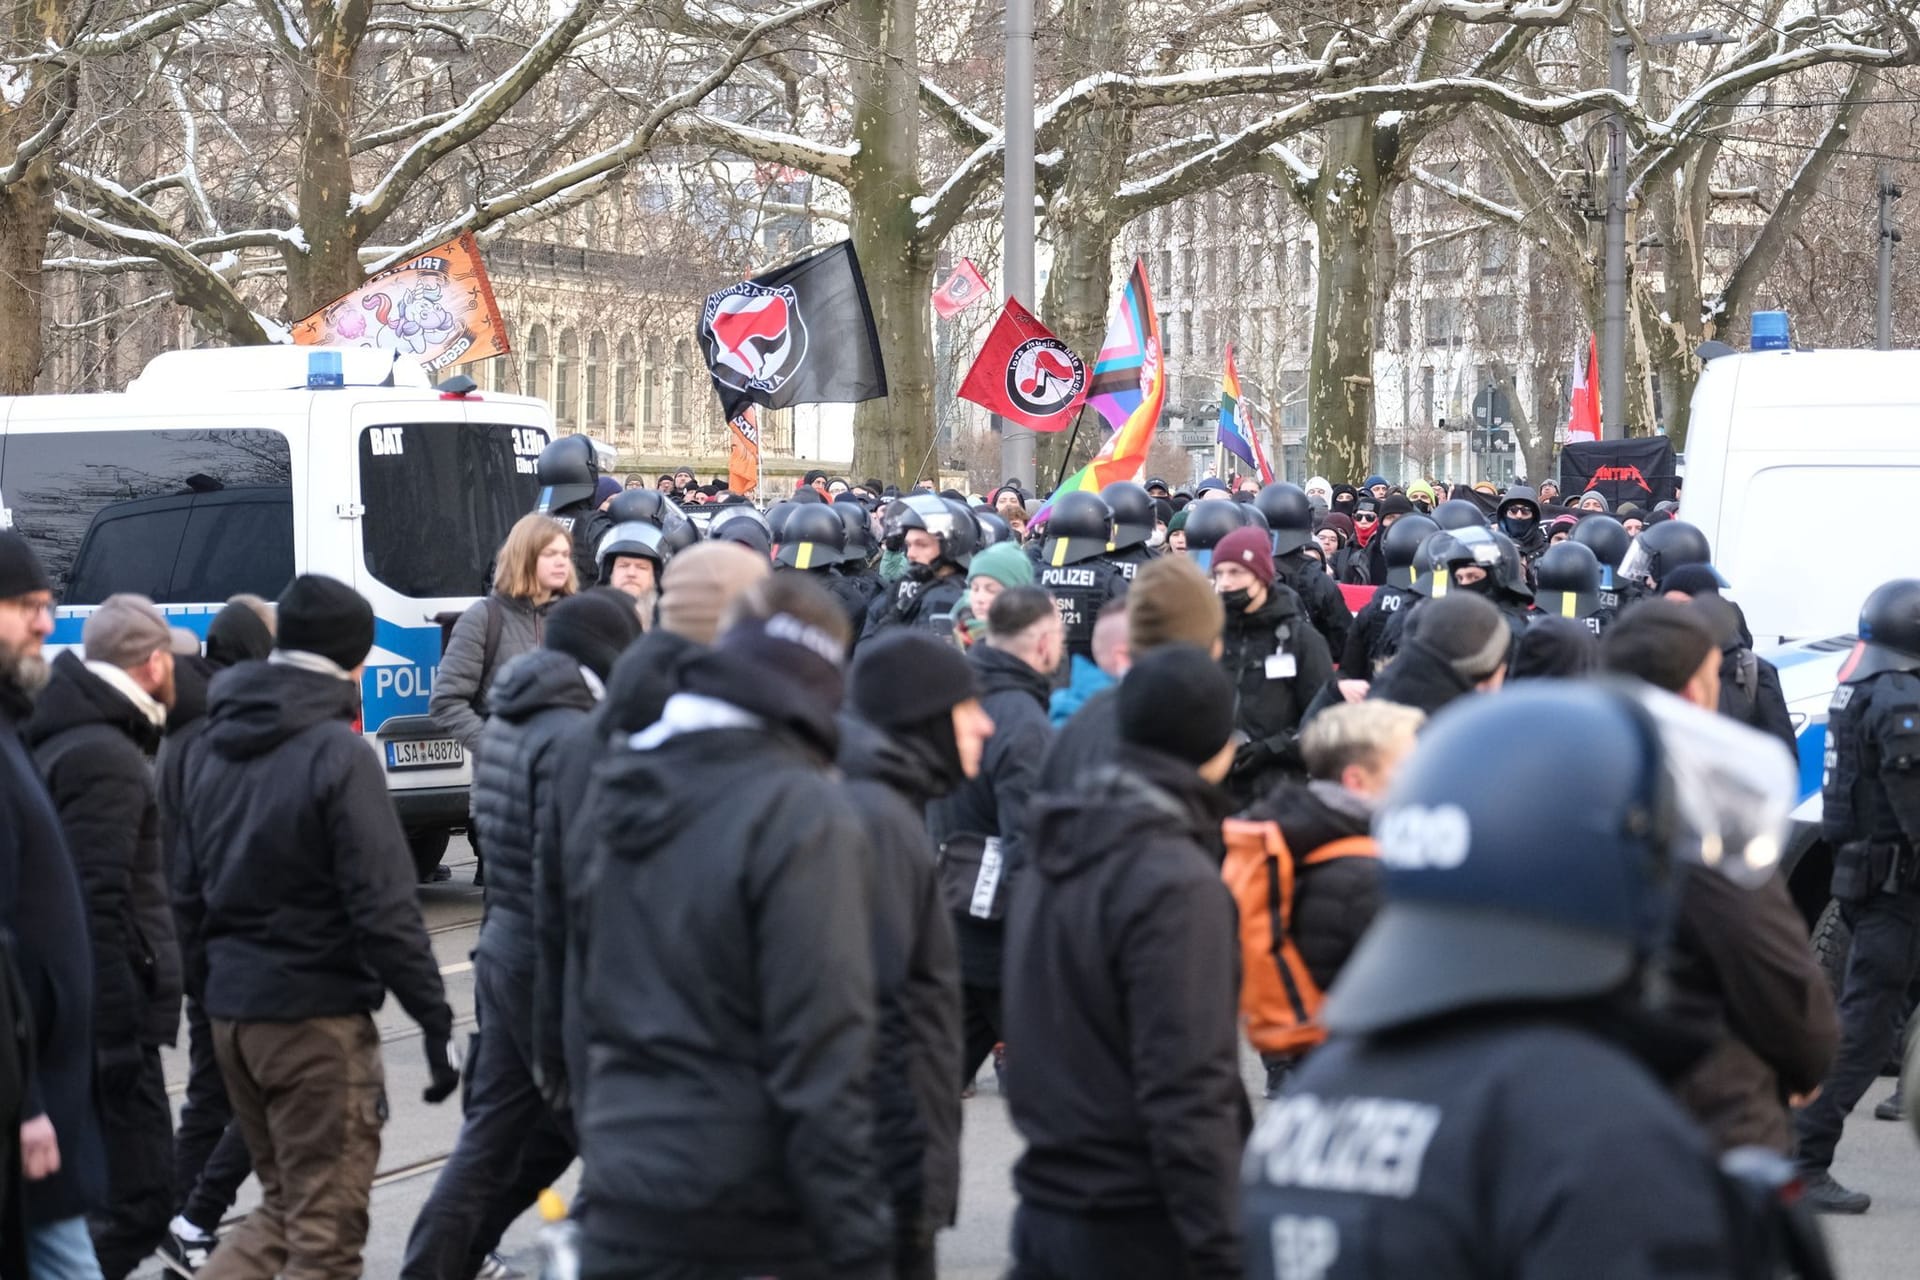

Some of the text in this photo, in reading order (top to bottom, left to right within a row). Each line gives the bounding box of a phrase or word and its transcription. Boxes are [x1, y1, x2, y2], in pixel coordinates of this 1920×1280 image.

[370, 427, 403, 456] BAT
[1583, 464, 1653, 493] ANTIFA
[1041, 569, 1095, 586] POLIZEI
[396, 741, 460, 763] LSA 48878
